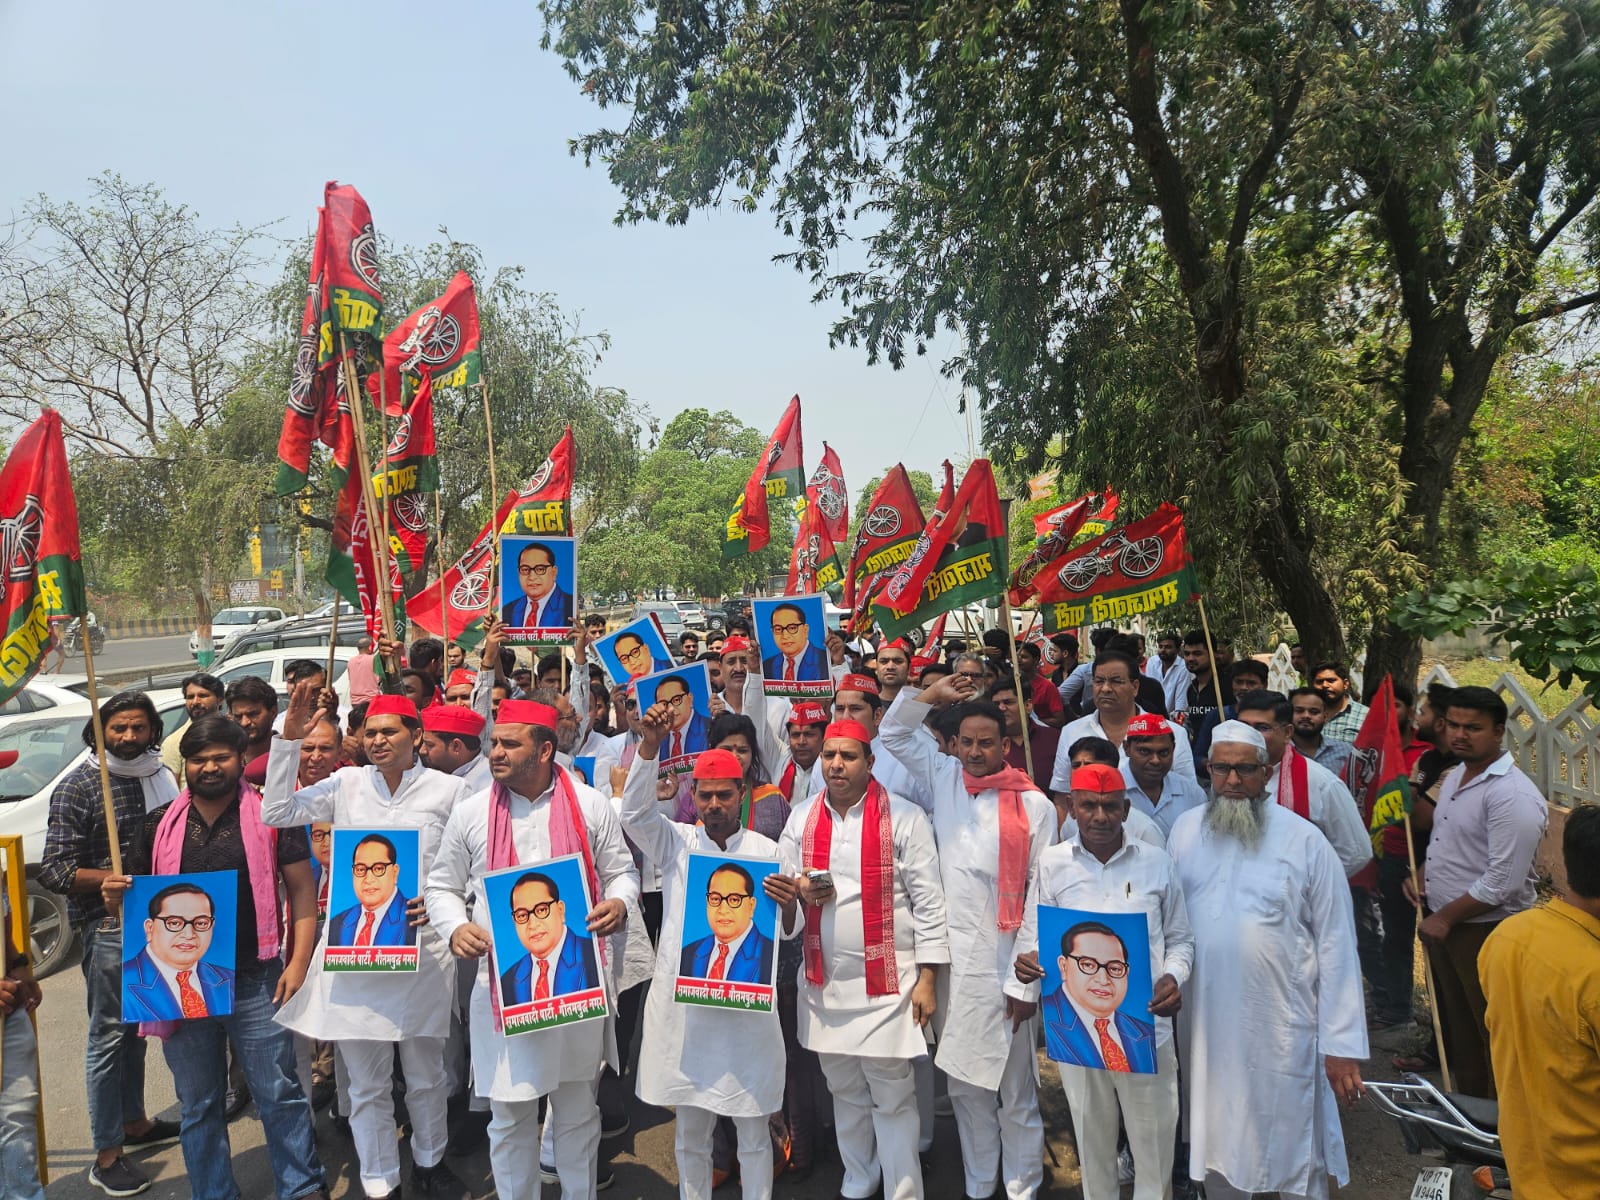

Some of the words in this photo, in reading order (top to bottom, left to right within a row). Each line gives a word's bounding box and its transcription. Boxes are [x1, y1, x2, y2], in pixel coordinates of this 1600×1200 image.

[522, 501, 565, 532] पार्टी
[326, 950, 356, 966] समाजवादी
[375, 949, 402, 970] गौतमबुद्ध
[402, 954, 416, 968] नगर
[677, 983, 709, 1000] समाजवादी
[728, 984, 756, 1008] गौतमबुद्ध
[757, 992, 771, 1009] नगर
[505, 1006, 540, 1029] समाजवादी
[559, 999, 589, 1018] गौतमबुद्ध
[588, 996, 605, 1011] नगर
